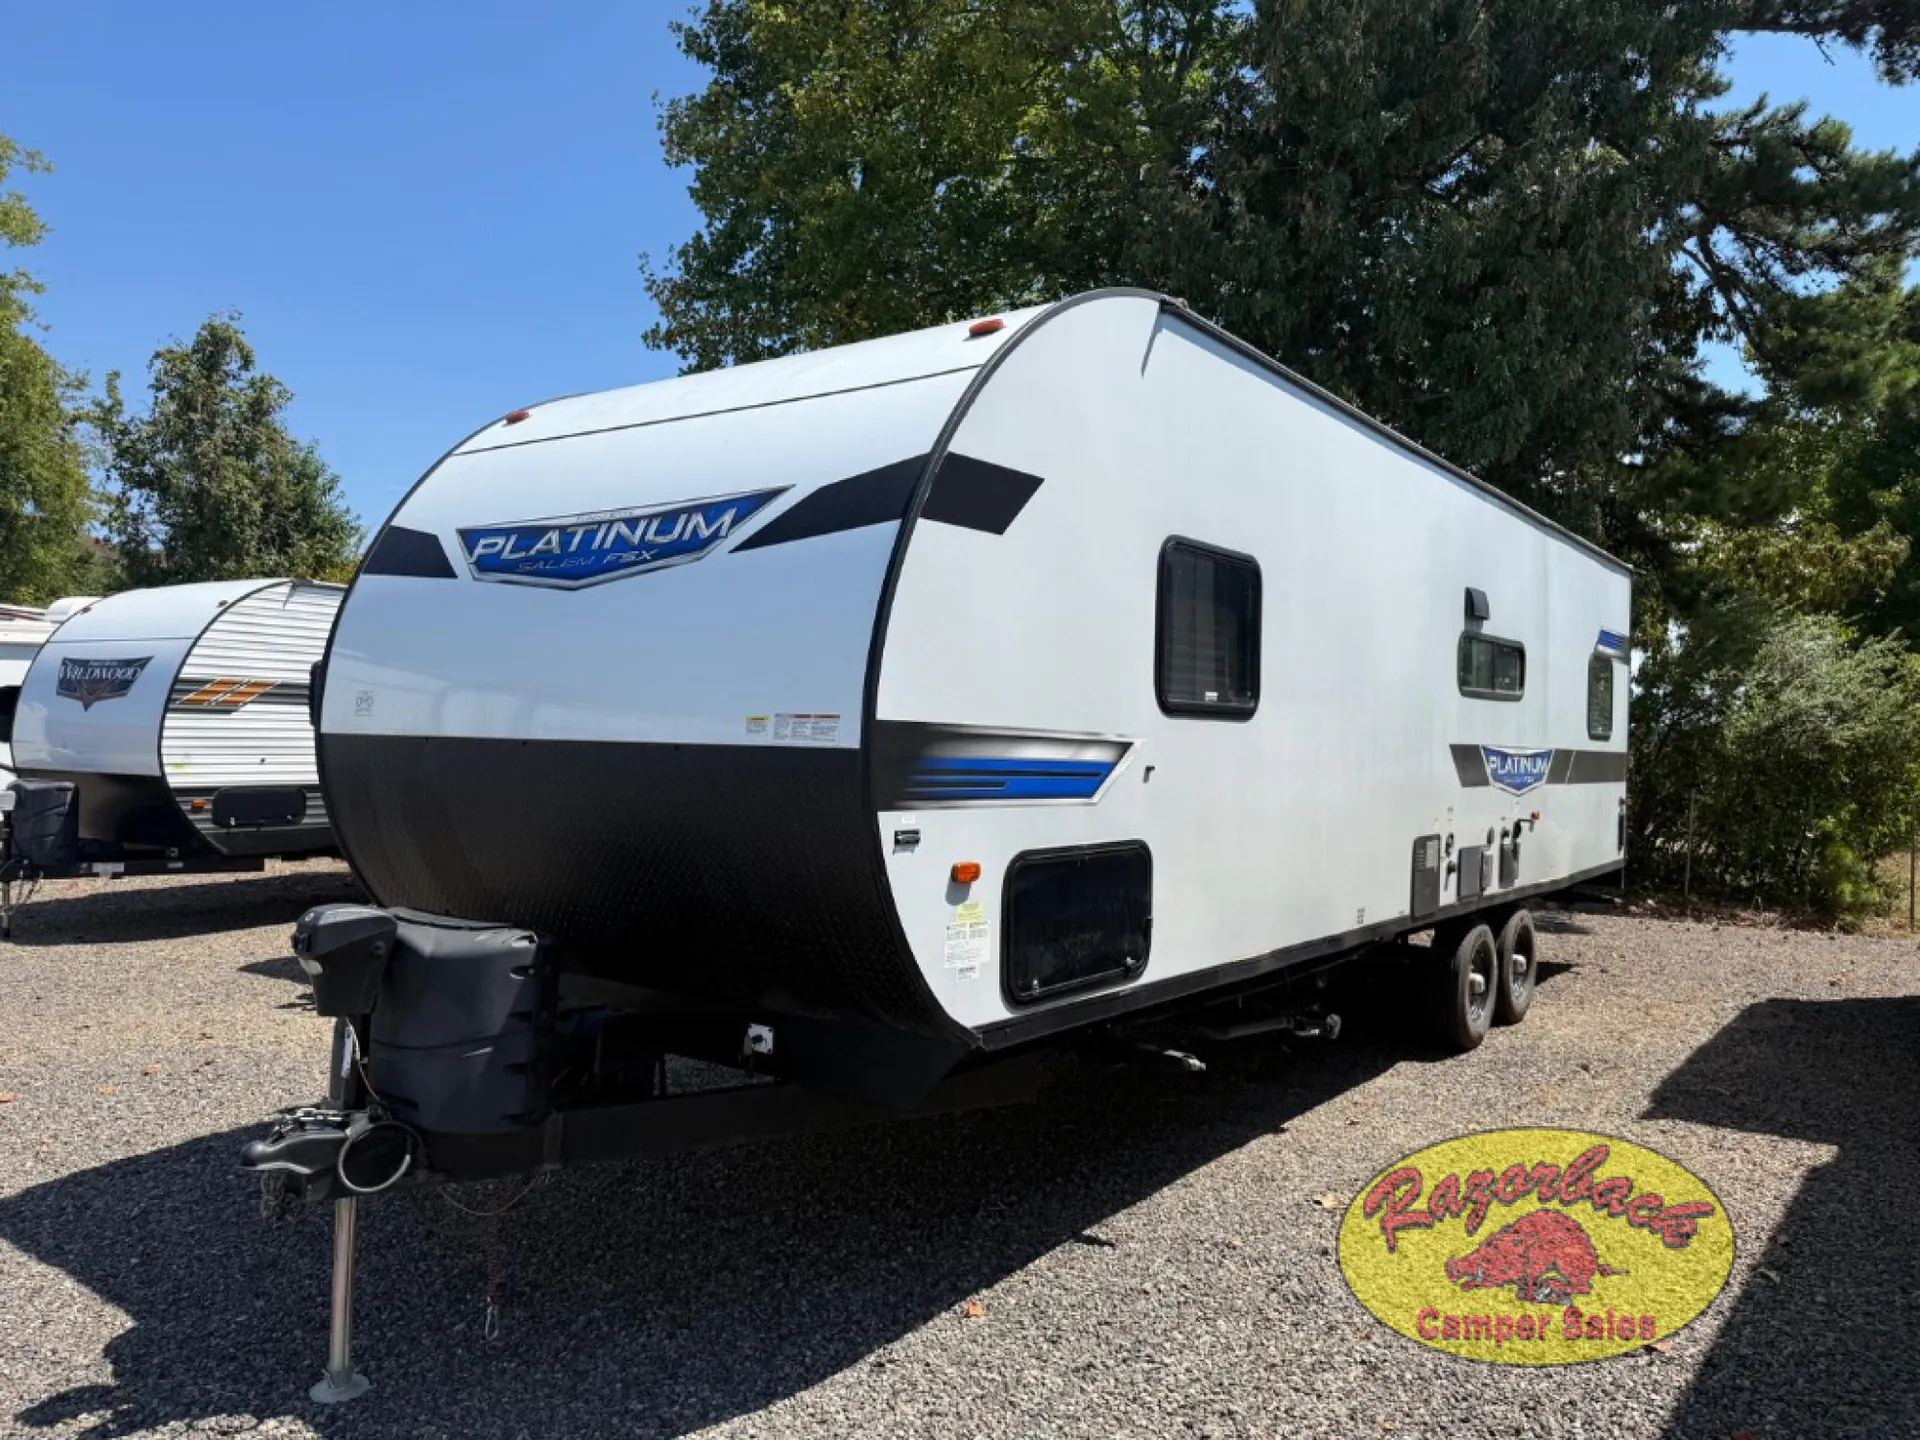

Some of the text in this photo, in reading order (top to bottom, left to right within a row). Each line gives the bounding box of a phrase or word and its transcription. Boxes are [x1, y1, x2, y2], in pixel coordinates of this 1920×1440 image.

[469, 507, 738, 564] PLATINUM
[516, 549, 659, 573] SALEM FSX
[1488, 755, 1548, 774] PLATINUM
